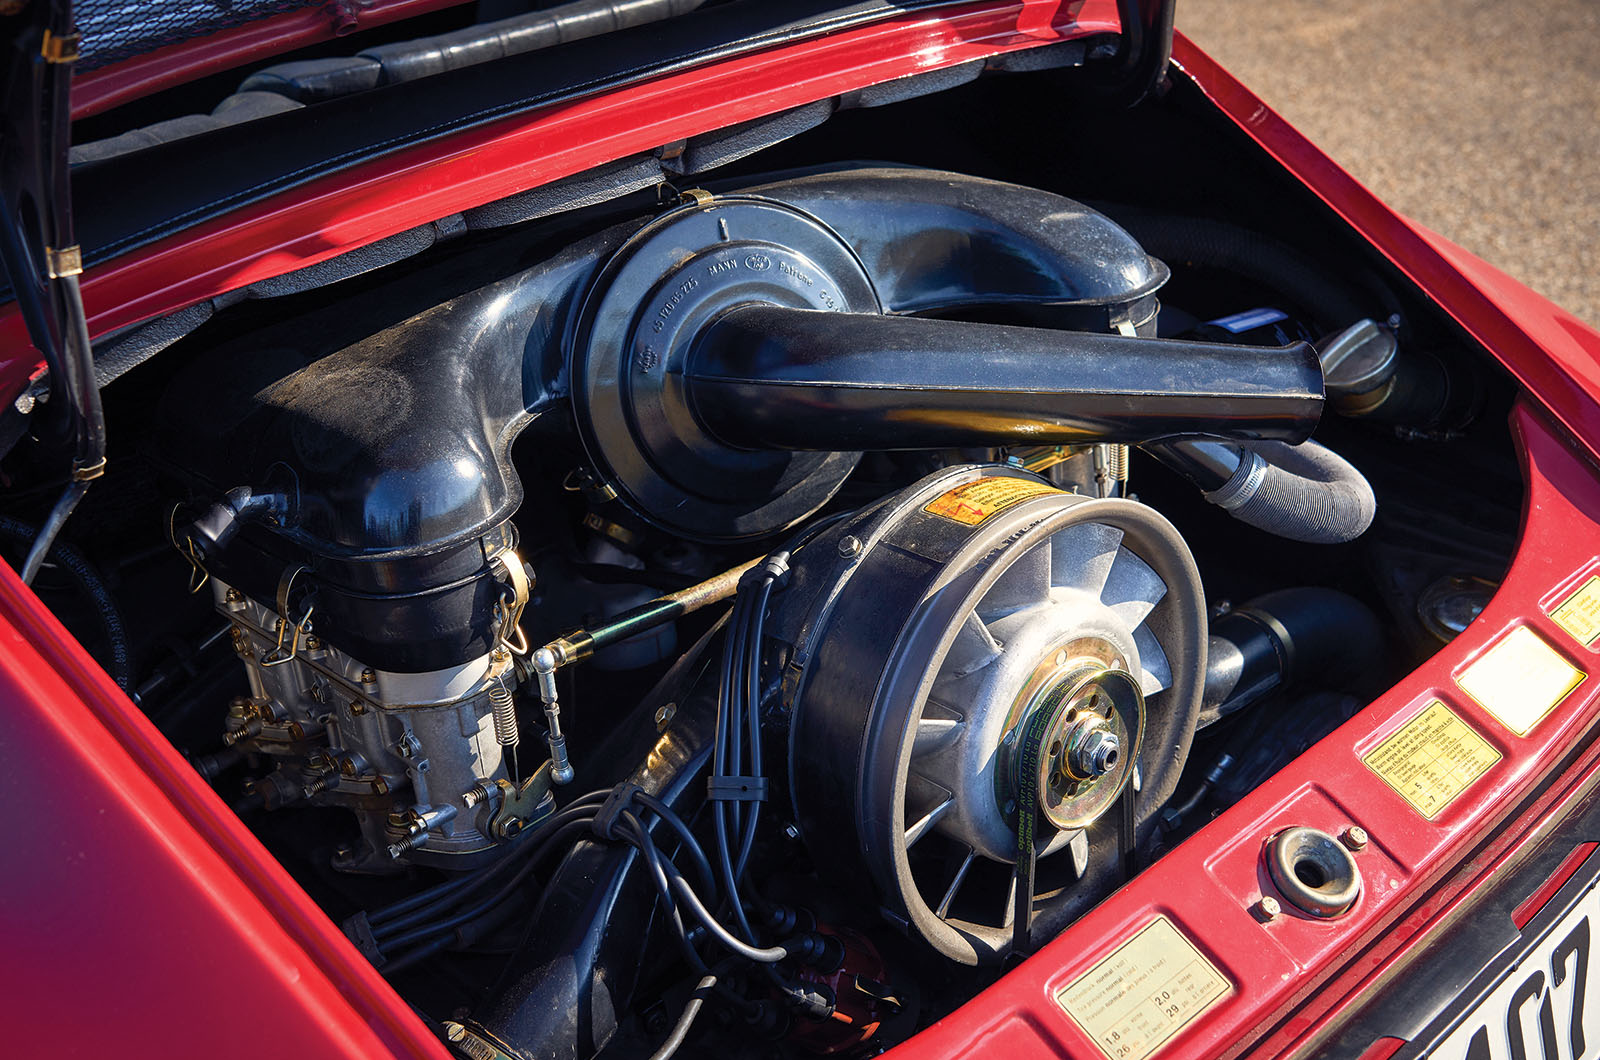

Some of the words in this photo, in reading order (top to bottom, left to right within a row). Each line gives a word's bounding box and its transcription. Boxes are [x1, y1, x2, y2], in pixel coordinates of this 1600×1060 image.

[708, 259, 738, 276] MANN
[778, 261, 813, 287] Patrone
[1034, 684, 1071, 740] PORSCHE
[1466, 915, 1590, 1060] 07
[1166, 1005, 1180, 1018] 29
[1116, 1045, 1131, 1058] 26
